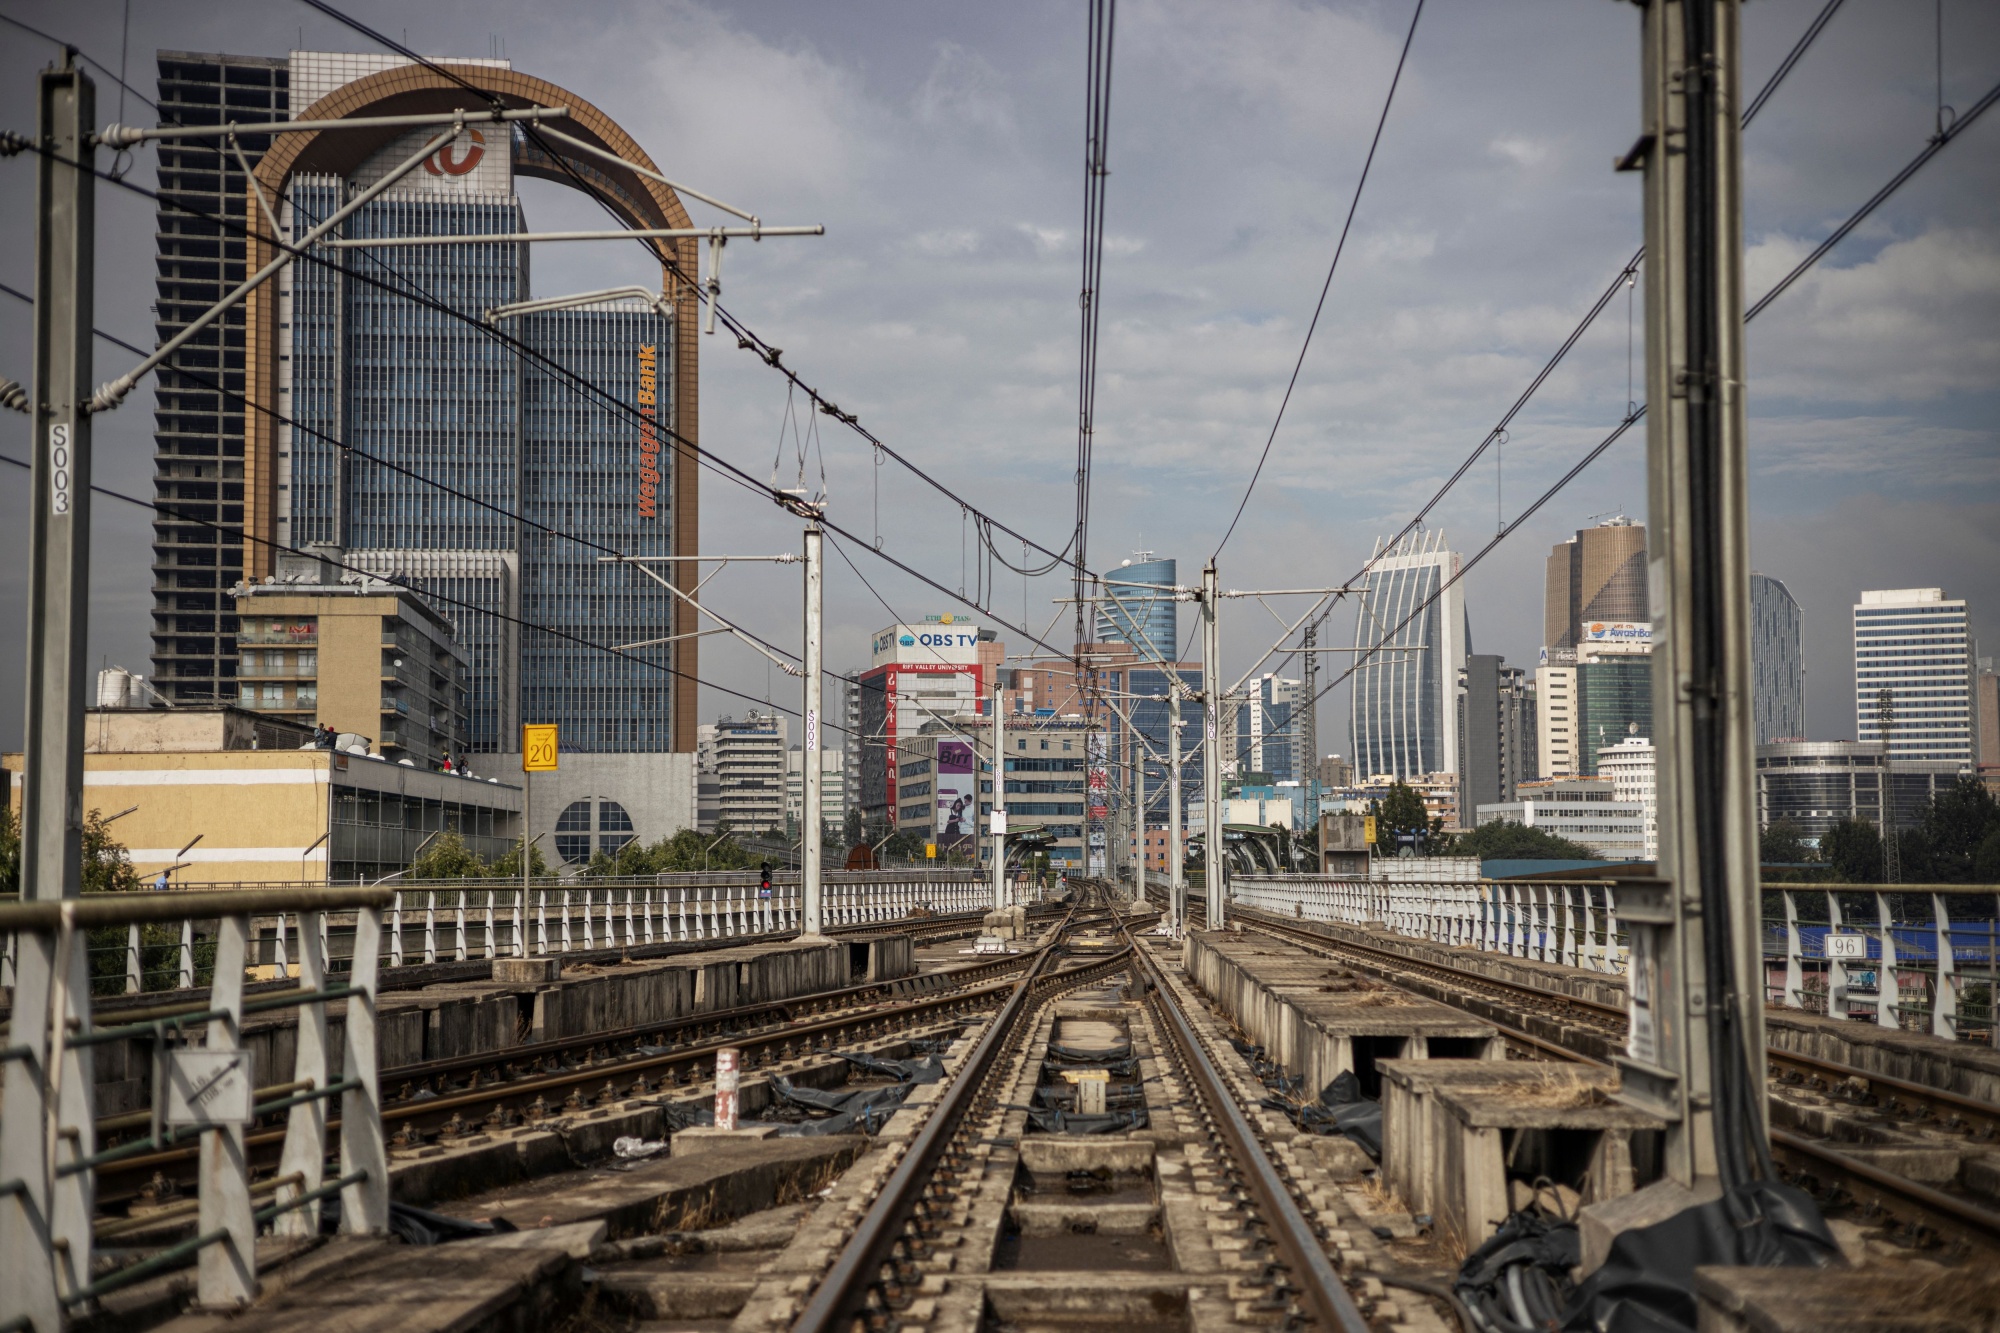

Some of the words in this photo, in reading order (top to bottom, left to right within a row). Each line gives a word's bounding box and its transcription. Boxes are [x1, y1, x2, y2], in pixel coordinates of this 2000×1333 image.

[638, 343, 656, 406] Bank
[53, 425, 69, 513] S003
[638, 407, 660, 518] Wegagen
[880, 634, 888, 652] OBS
[920, 633, 953, 647] OBS
[956, 634, 978, 647] TV
[530, 743, 553, 763] 20
[939, 750, 973, 764] Birr
[1835, 938, 1855, 955] 96
